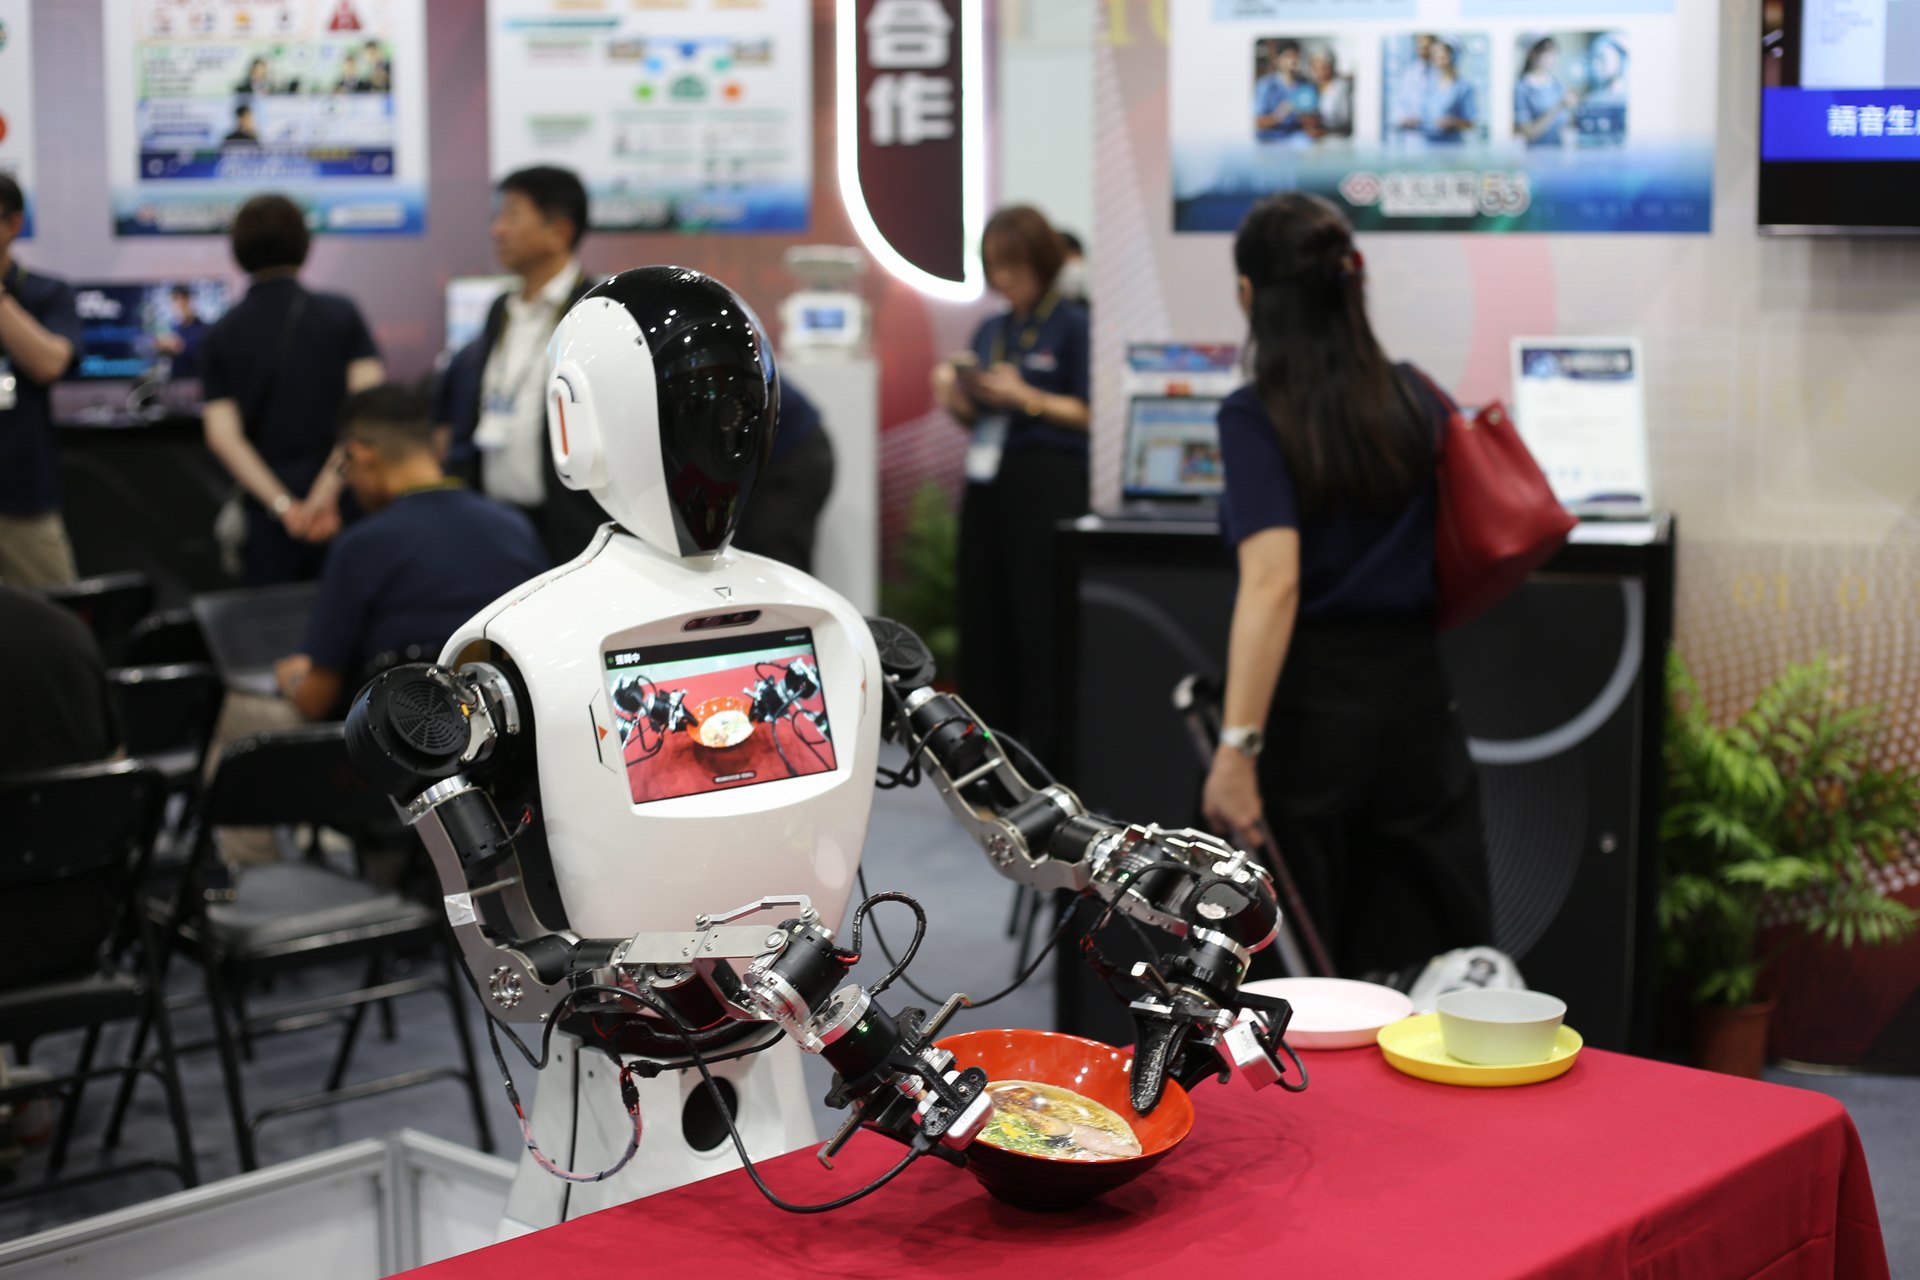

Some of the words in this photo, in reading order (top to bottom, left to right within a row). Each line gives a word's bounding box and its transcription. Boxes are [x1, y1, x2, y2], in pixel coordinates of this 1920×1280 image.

[864, 0, 955, 146] 合作
[1826, 104, 1920, 137] 語音生
